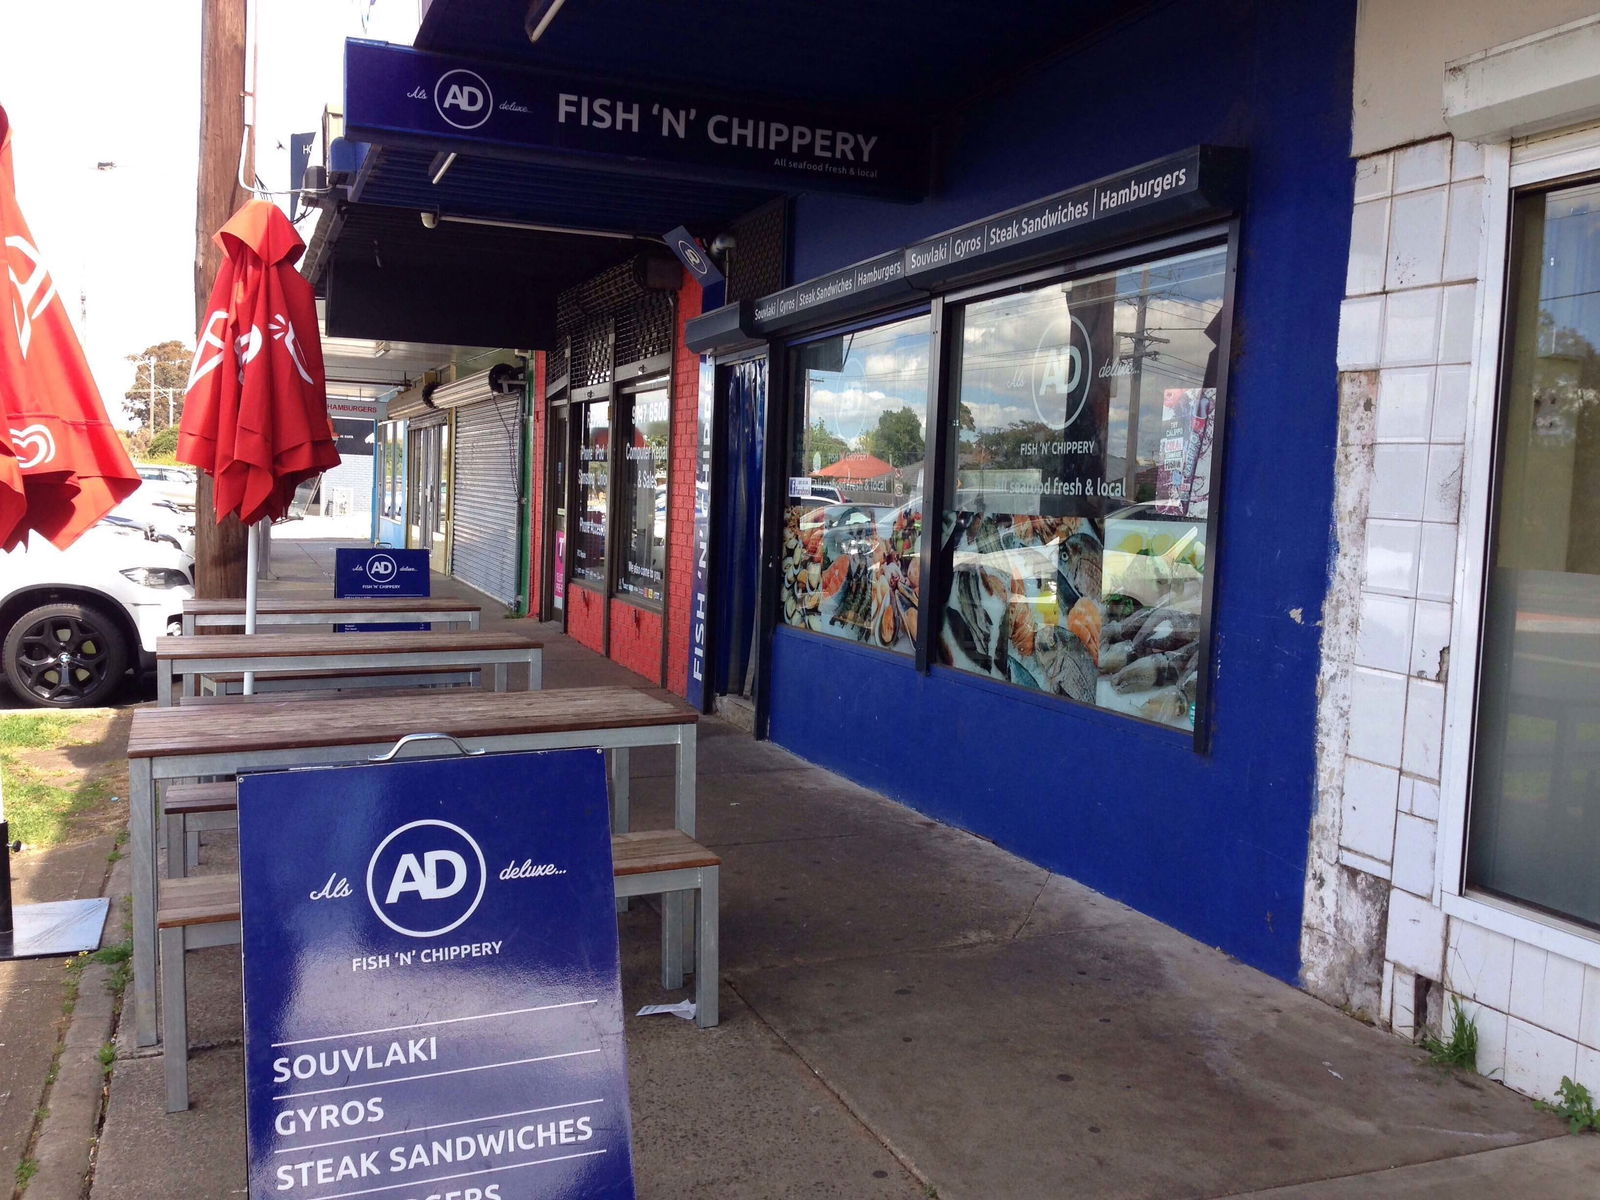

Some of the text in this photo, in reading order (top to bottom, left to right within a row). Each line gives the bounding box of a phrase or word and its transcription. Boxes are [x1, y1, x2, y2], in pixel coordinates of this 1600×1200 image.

[407, 86, 427, 99] Als
[443, 84, 484, 112] AD
[558, 93, 639, 132] FISH
[707, 114, 878, 163] CHIPPERY
[774, 158, 787, 167] All
[788, 161, 823, 172] seafood
[825, 164, 847, 175] fresh
[857, 169, 877, 178] local
[911, 168, 1187, 269] Souvlaki Gyros Steak Sandwiches Hamburgers
[754, 261, 901, 321] Souvlaki Gyros Steak Sandwiches Hamburgers
[1039, 345, 1082, 396] AD
[327, 403, 377, 413] HAMBURGERS
[649, 400, 669, 422] 6500
[626, 442, 651, 465] Computer
[1020, 442, 1038, 455] FISH
[1052, 441, 1095, 455] CHIPPERY
[637, 470, 657, 489] & Sales
[871, 478, 887, 491] local
[1010, 477, 1051, 494] seafood
[1054, 477, 1082, 496] fresh
[1085, 478, 1093, 496] &
[1097, 477, 1126, 497] local
[371, 561, 392, 574] AD
[693, 593, 705, 681] FISH
[309, 872, 353, 901] Als
[385, 849, 467, 904] AD
[352, 954, 390, 972] FISH
[420, 940, 503, 963] CHIPPERY
[273, 1036, 438, 1083] SOUVLAKI
[274, 1097, 384, 1136] GYROS
[276, 1116, 593, 1191] STEAK SANDWICHES
